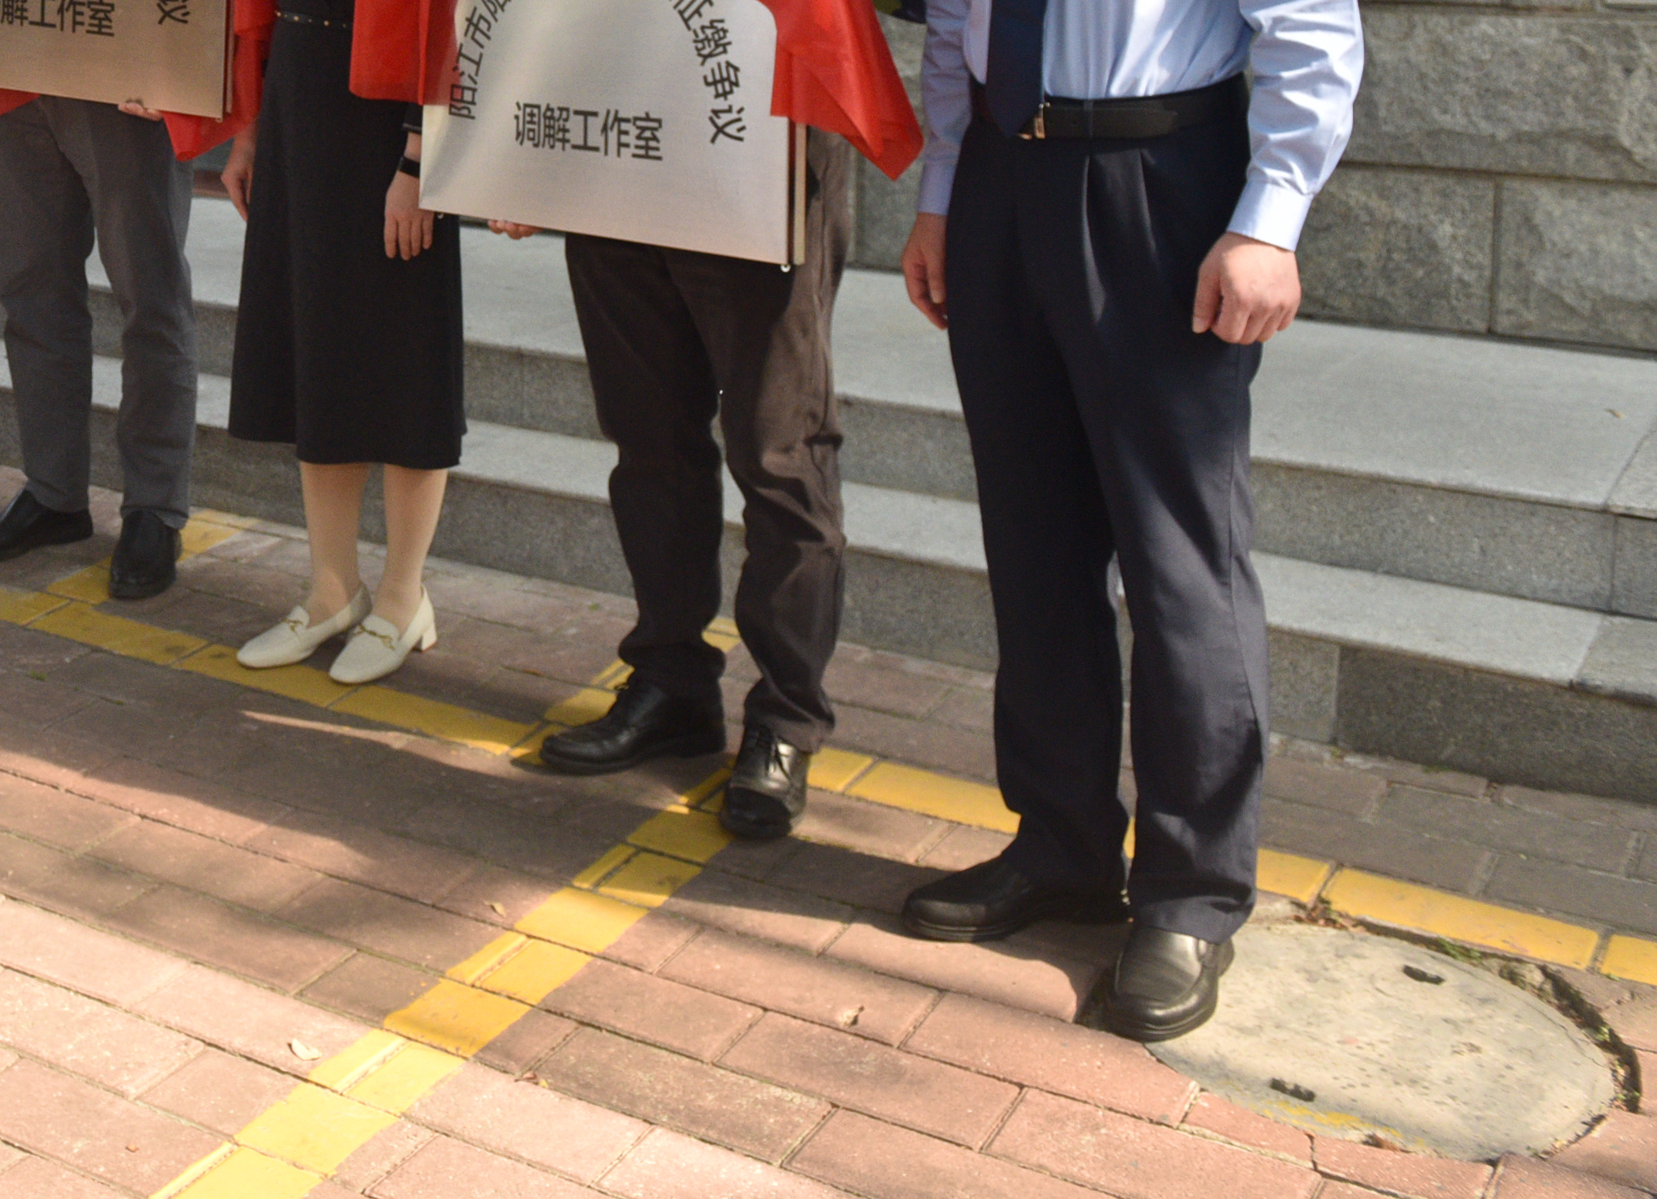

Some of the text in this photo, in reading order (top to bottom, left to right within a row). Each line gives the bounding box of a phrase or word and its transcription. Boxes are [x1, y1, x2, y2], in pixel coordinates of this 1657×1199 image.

[513, 101, 663, 161] 调解工作室
